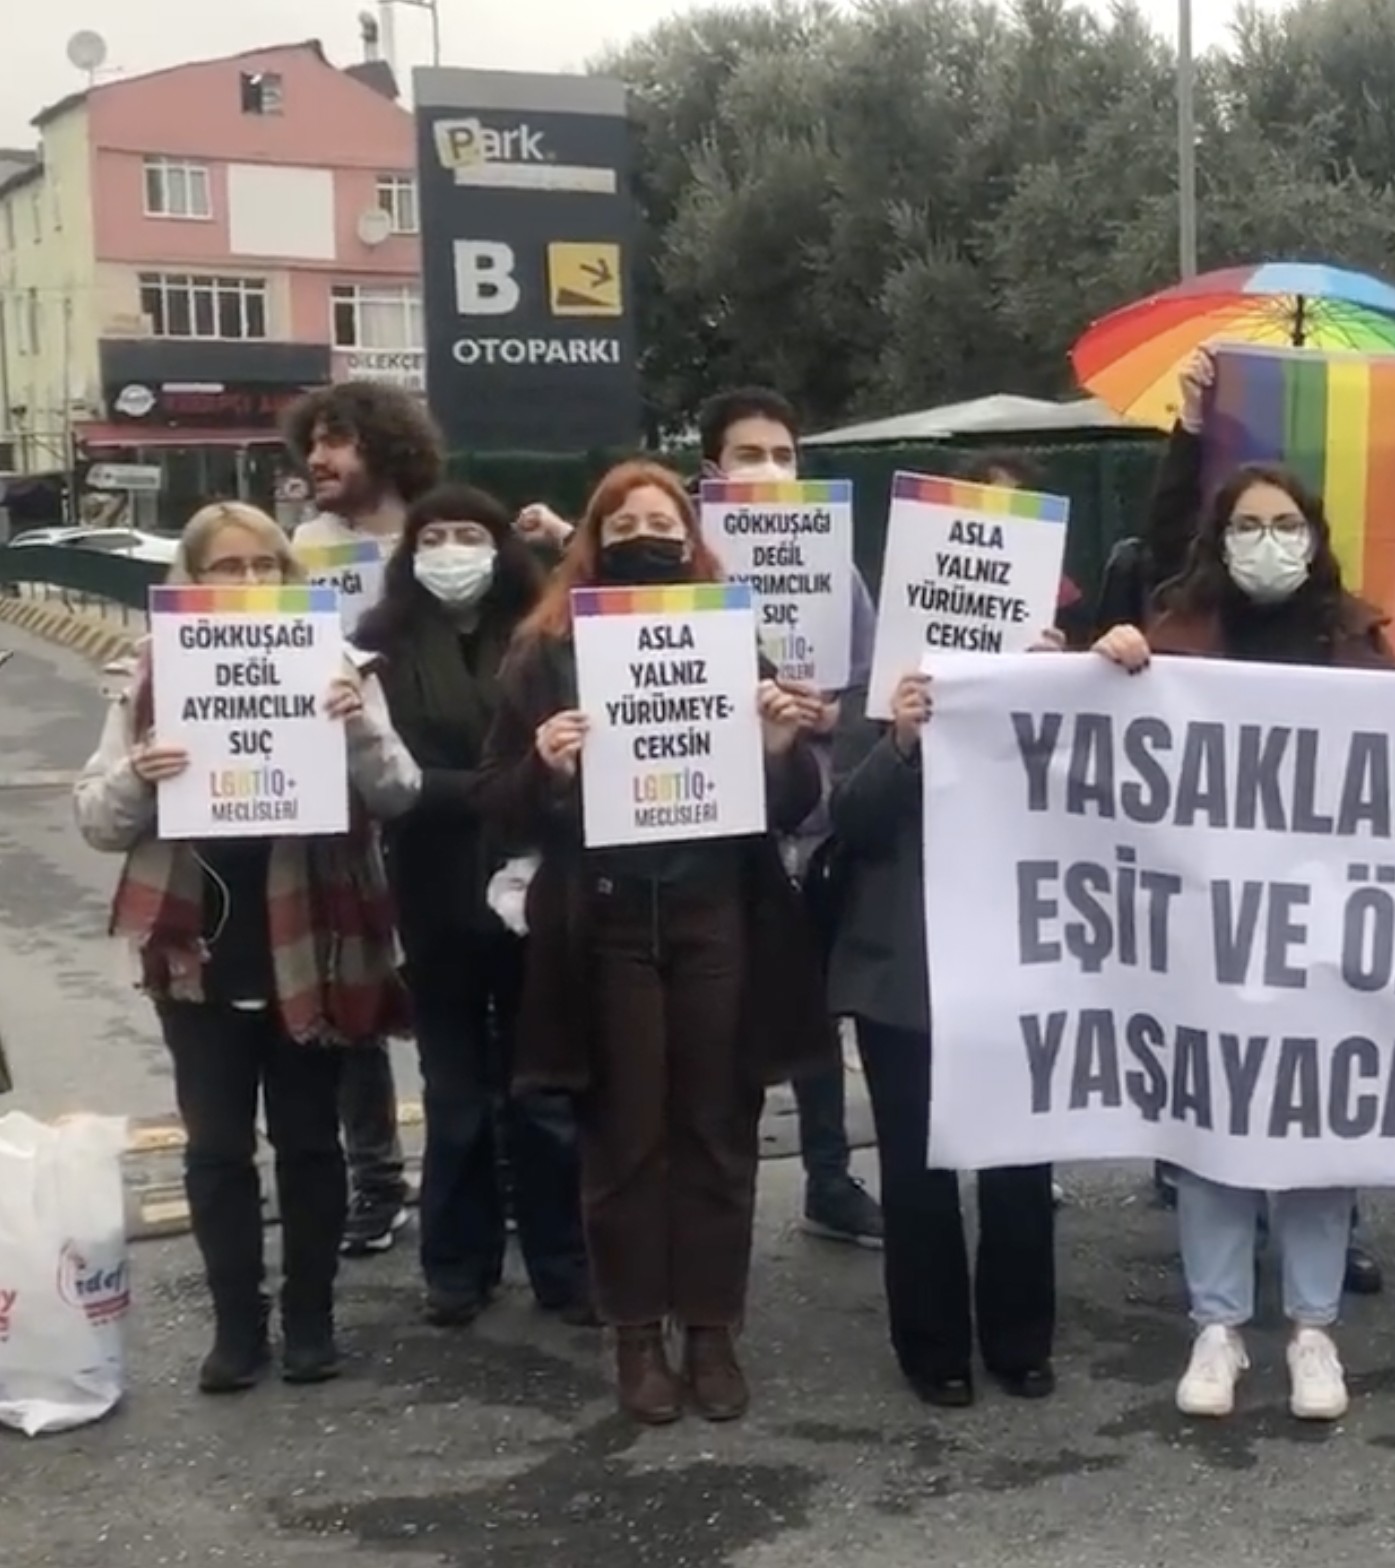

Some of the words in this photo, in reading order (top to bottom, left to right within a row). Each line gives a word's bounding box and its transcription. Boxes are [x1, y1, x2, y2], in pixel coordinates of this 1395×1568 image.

[453, 239, 520, 315] B
[453, 338, 620, 364] OTOPARKI
[723, 508, 831, 541] GÖKKUŞAĞI
[948, 520, 1004, 550] ASLA
[752, 540, 805, 567] DEĞİL
[936, 552, 1012, 585] YALNIZ
[728, 573, 832, 595] RIMCILIK
[906, 579, 1030, 623] YÜRÜMEYE-
[762, 603, 799, 630] SUÇ
[179, 619, 314, 654] GÖKKUŞAĞI
[638, 624, 695, 651] ASLA
[926, 621, 1003, 653] CEKSİN
[215, 657, 281, 686] DEĞİL
[629, 660, 707, 689] YALNIZ
[181, 694, 316, 721] AYRIMCILIK
[606, 692, 734, 726] YÜRÜMEYE-
[229, 730, 273, 760] SUÇ
[633, 729, 711, 760] CEKSİN
[211, 799, 298, 823] MECLİSLERİ
[634, 800, 717, 827] MECLİSLERİ
[1016, 846, 1181, 973] EŞİT
[1211, 879, 1310, 989] VE
